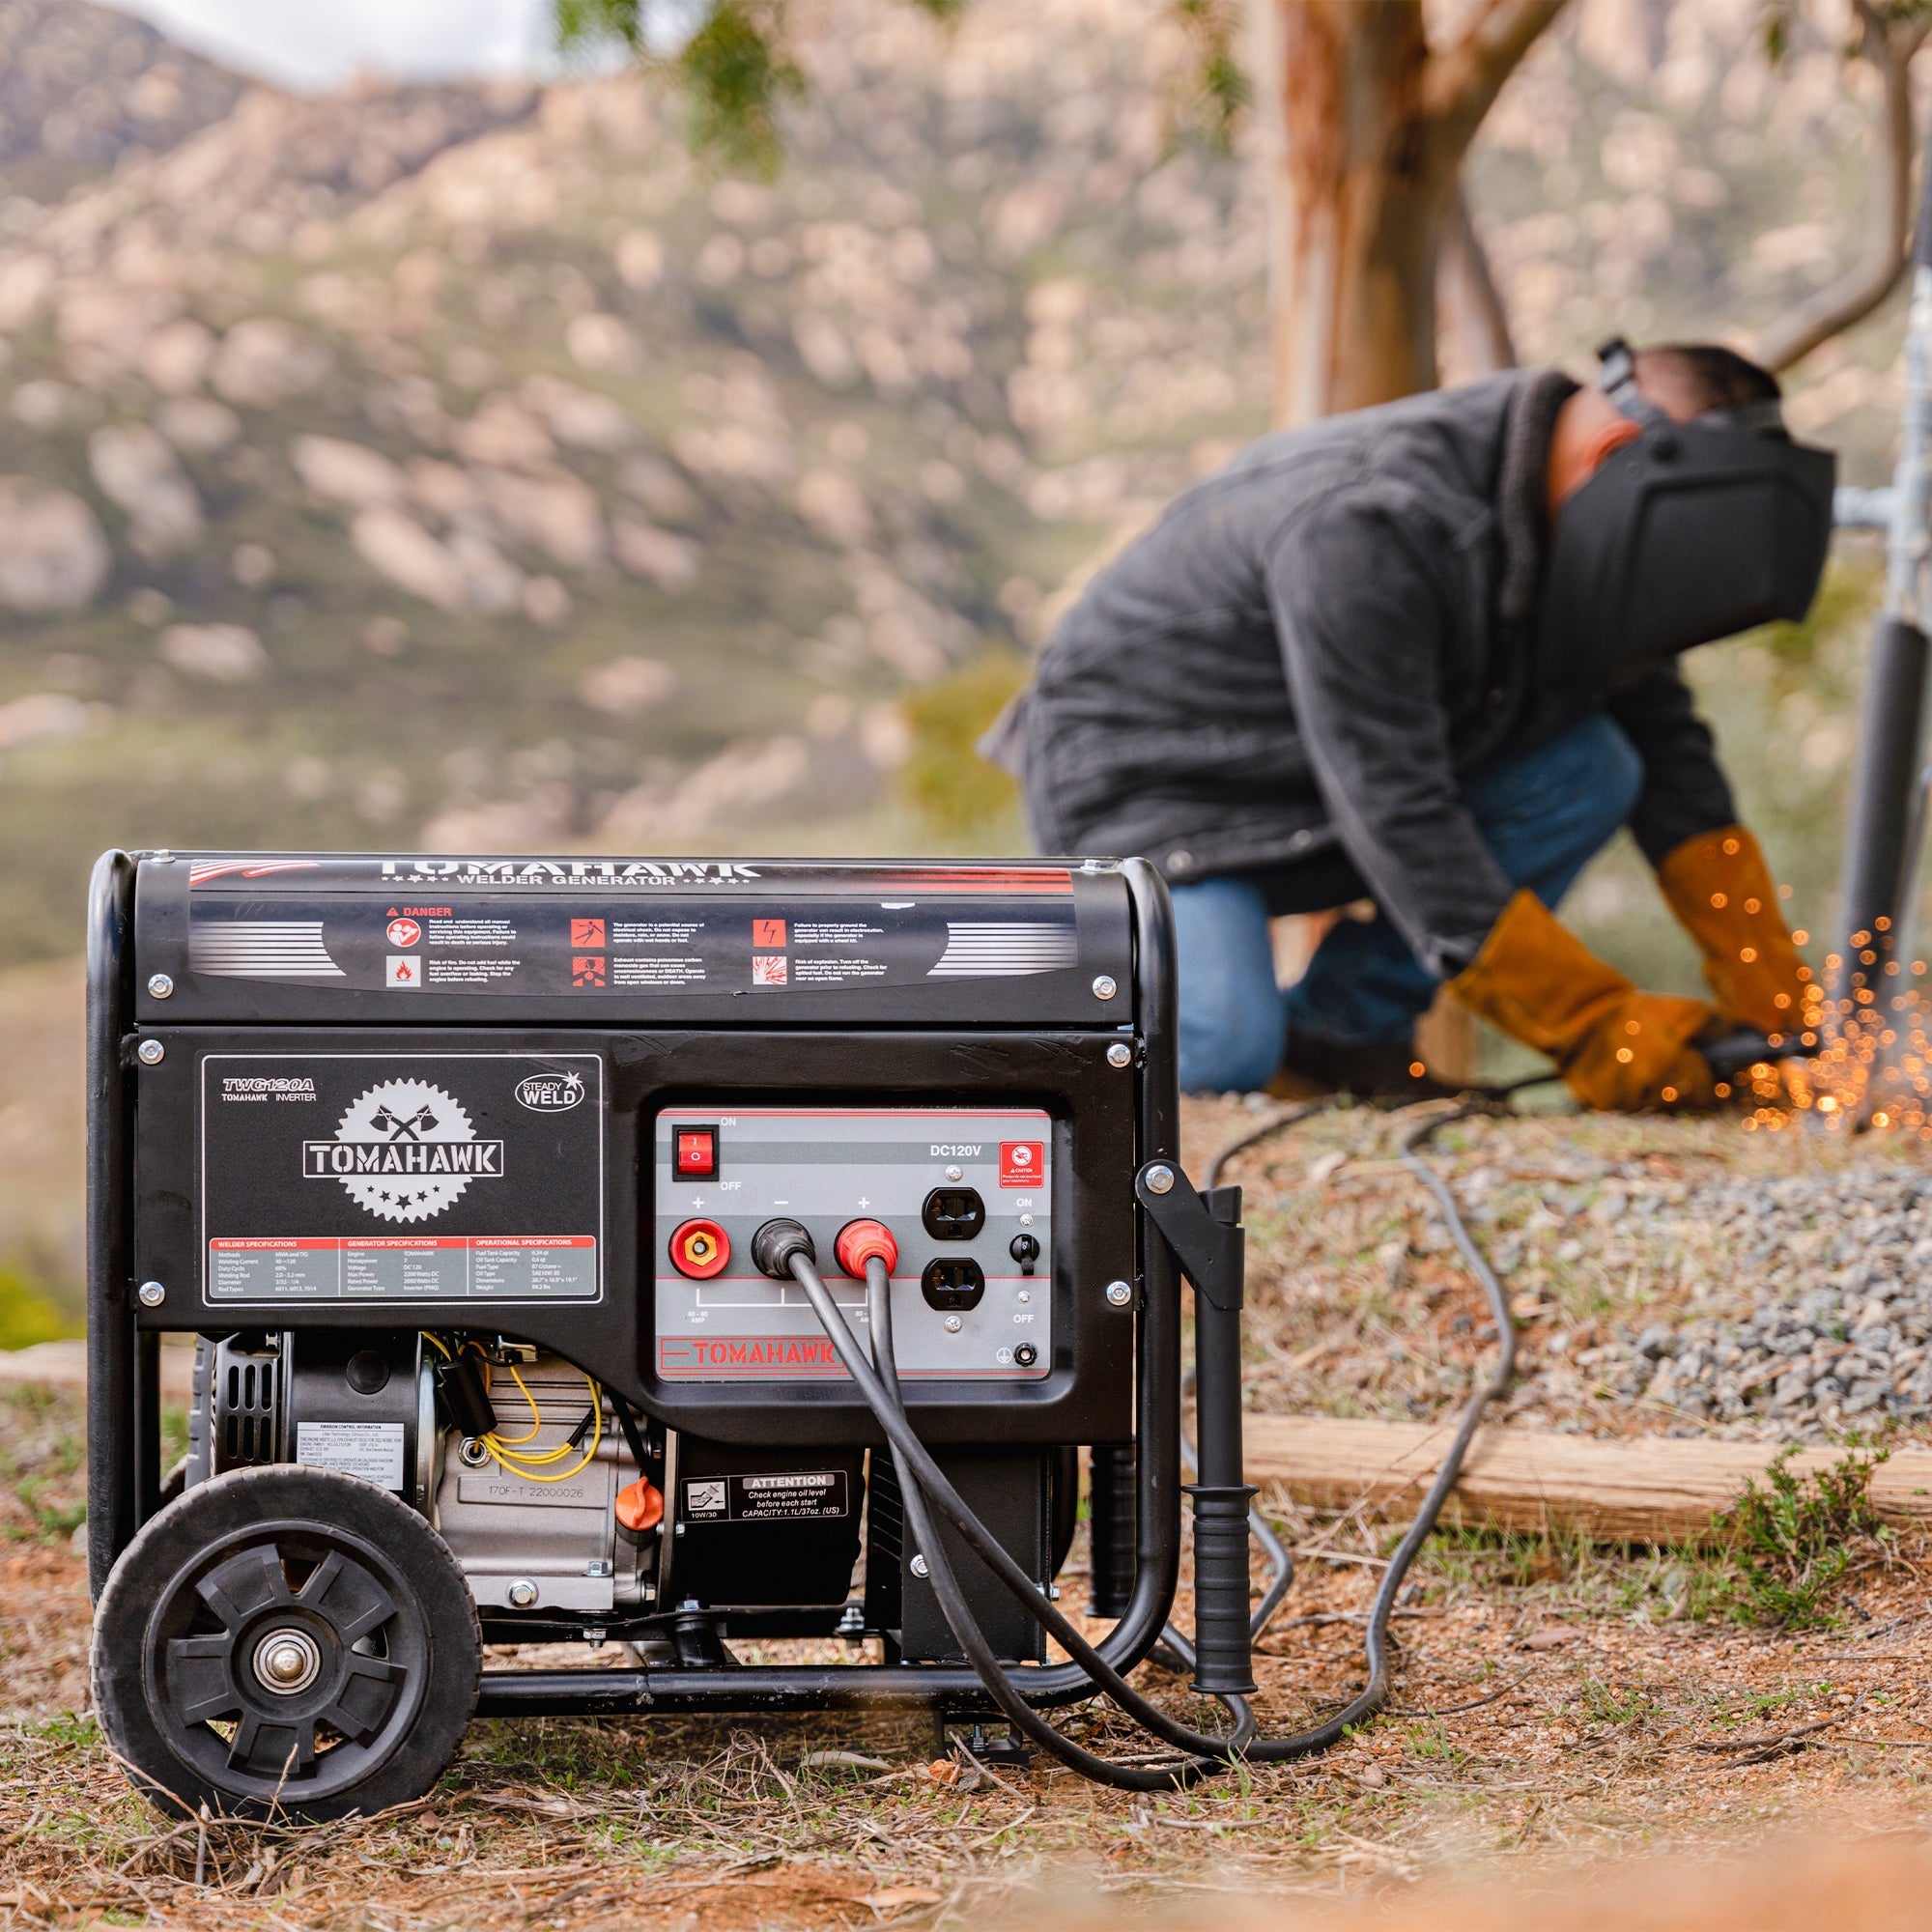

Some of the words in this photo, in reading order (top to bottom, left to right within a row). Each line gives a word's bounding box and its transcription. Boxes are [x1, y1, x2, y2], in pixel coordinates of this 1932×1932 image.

[382, 861, 761, 877] TOMAHAWK
[457, 874, 543, 885] WELDER
[552, 875, 676, 886] GENERATOR
[403, 907, 452, 916] DANGER
[223, 1078, 314, 1091] TWG120A
[523, 1082, 562, 1090] STEADY
[523, 1090, 576, 1104] WELD
[721, 1118, 736, 1126] ON
[930, 1145, 981, 1156] DC120V
[309, 1145, 497, 1173] TOMAHAWK
[721, 1182, 741, 1190] OFF
[1016, 1199, 1032, 1207] ON
[1013, 1315, 1034, 1323] OFF
[693, 1343, 836, 1364] TOMAHAWK
[752, 1476, 826, 1488] ATTENTION
[773, 1490, 797, 1499] engine
[742, 1508, 821, 1517] CAPACITY:1.1L/37oz.
[823, 1507, 839, 1515] (US)
